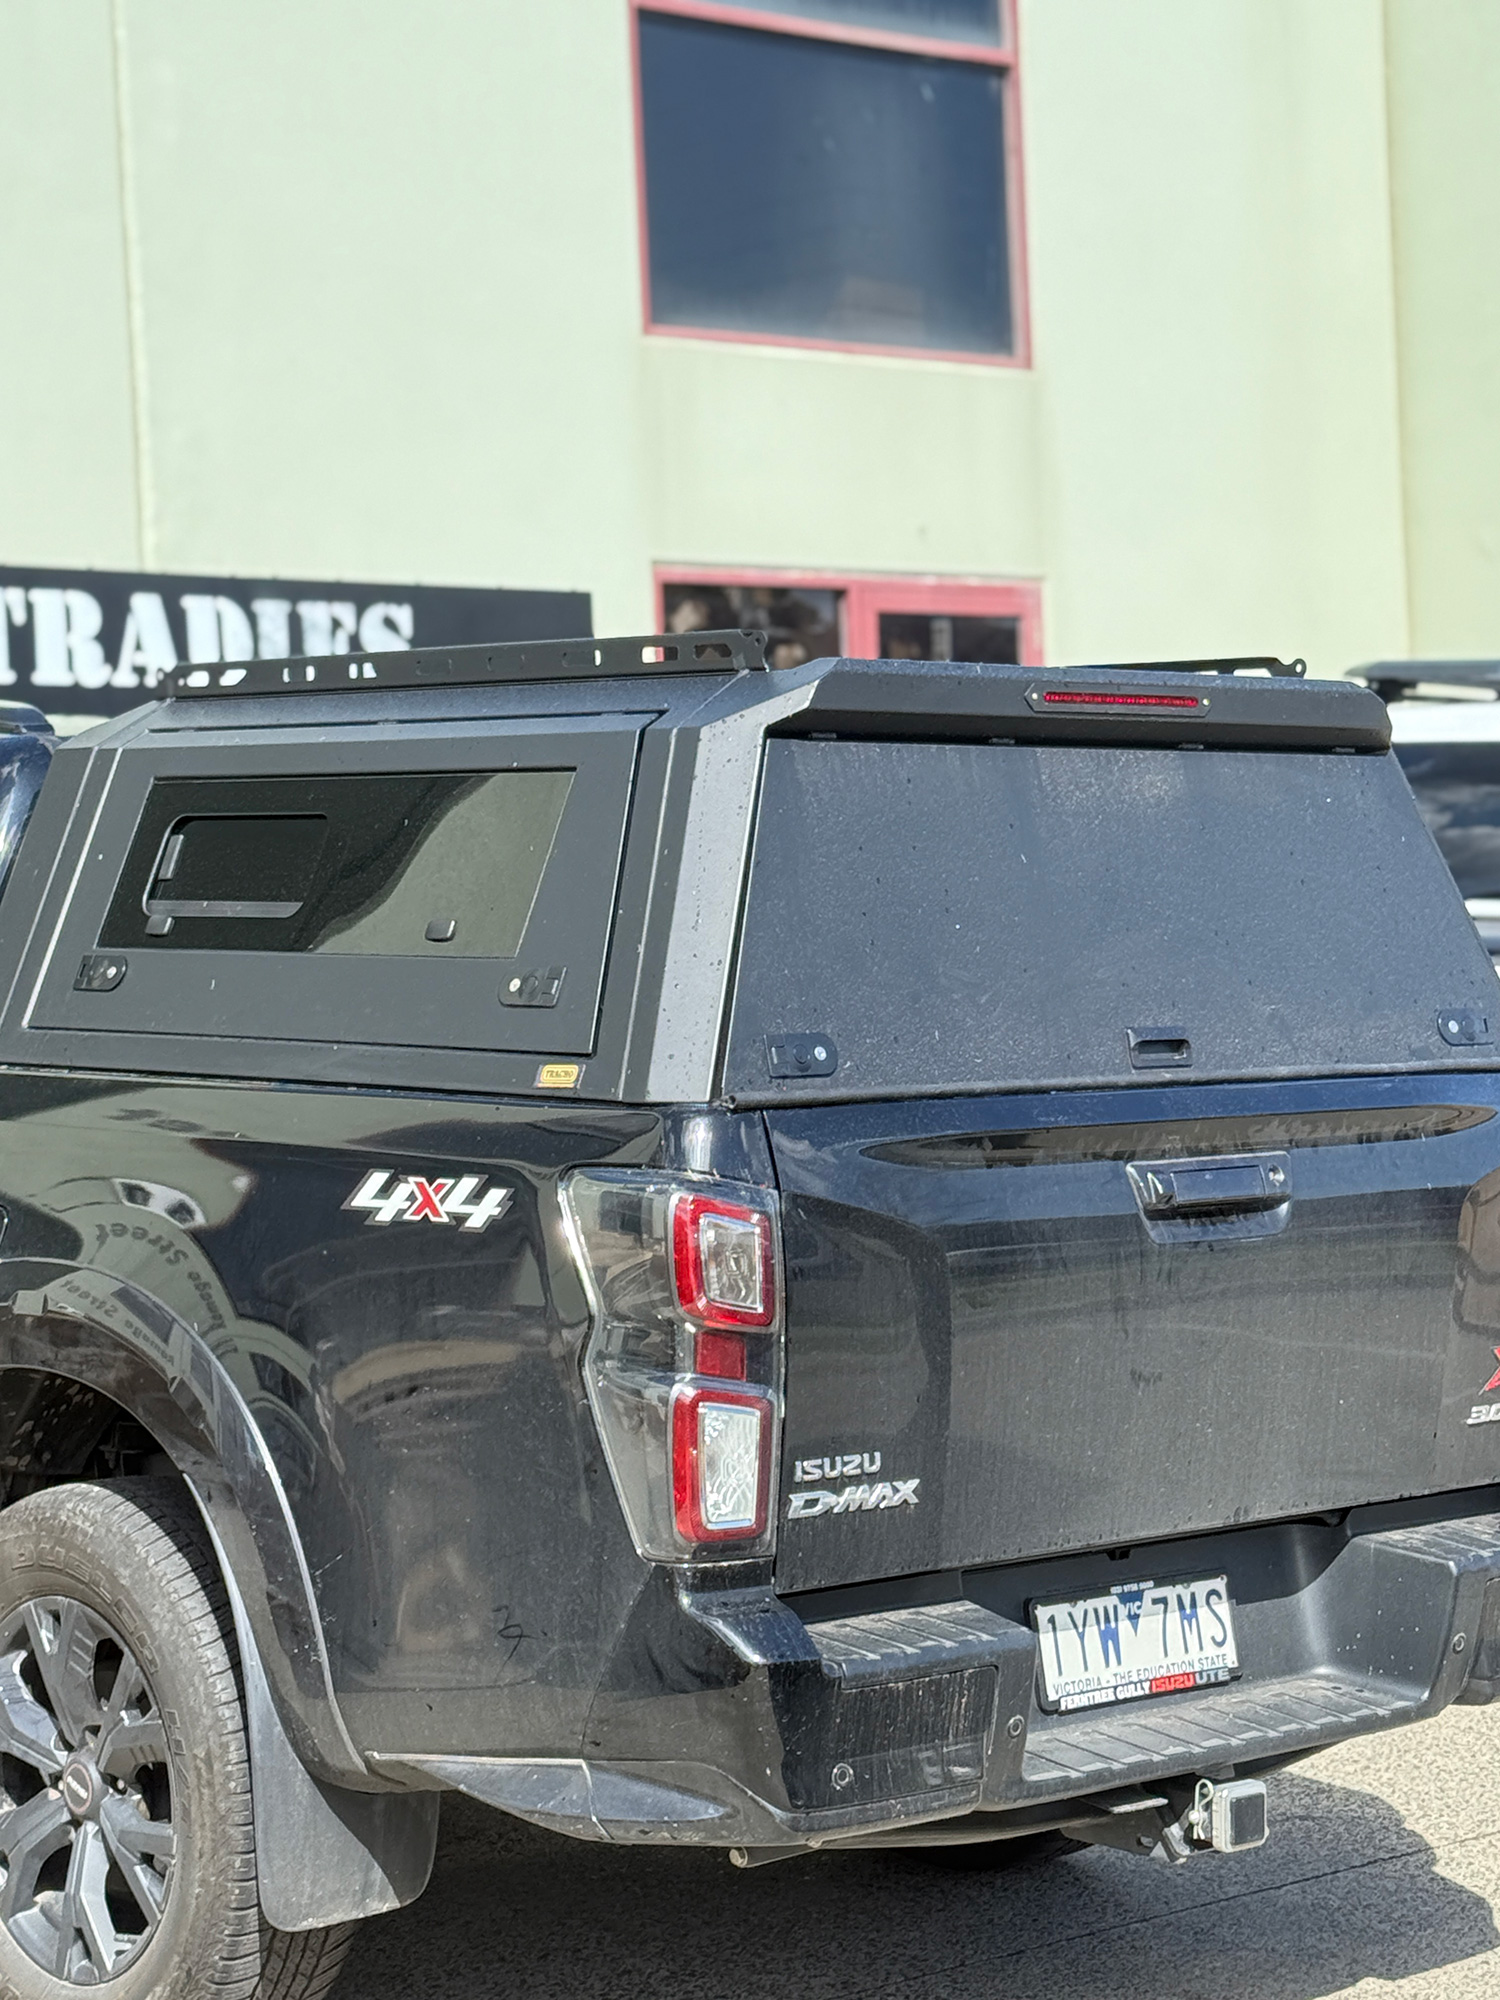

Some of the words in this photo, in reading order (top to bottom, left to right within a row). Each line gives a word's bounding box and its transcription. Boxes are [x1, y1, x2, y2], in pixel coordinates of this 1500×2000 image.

[794, 1451, 882, 1483] ISUZU
[1123, 1601, 1142, 1616] VIC
[1047, 1603, 1122, 1677] 1YW
[1151, 1588, 1229, 1658] 7MS
[1052, 1673, 1102, 1696] VICTORIA
[1112, 1667, 1134, 1684] THE
[1136, 1657, 1196, 1681] EDUCATION
[1197, 1653, 1228, 1671] STATE
[1060, 1687, 1116, 1711] FERNTREE
[1116, 1681, 1151, 1701] GULLY
[1151, 1674, 1196, 1693] ISUZU
[1195, 1667, 1231, 1685] UTE
